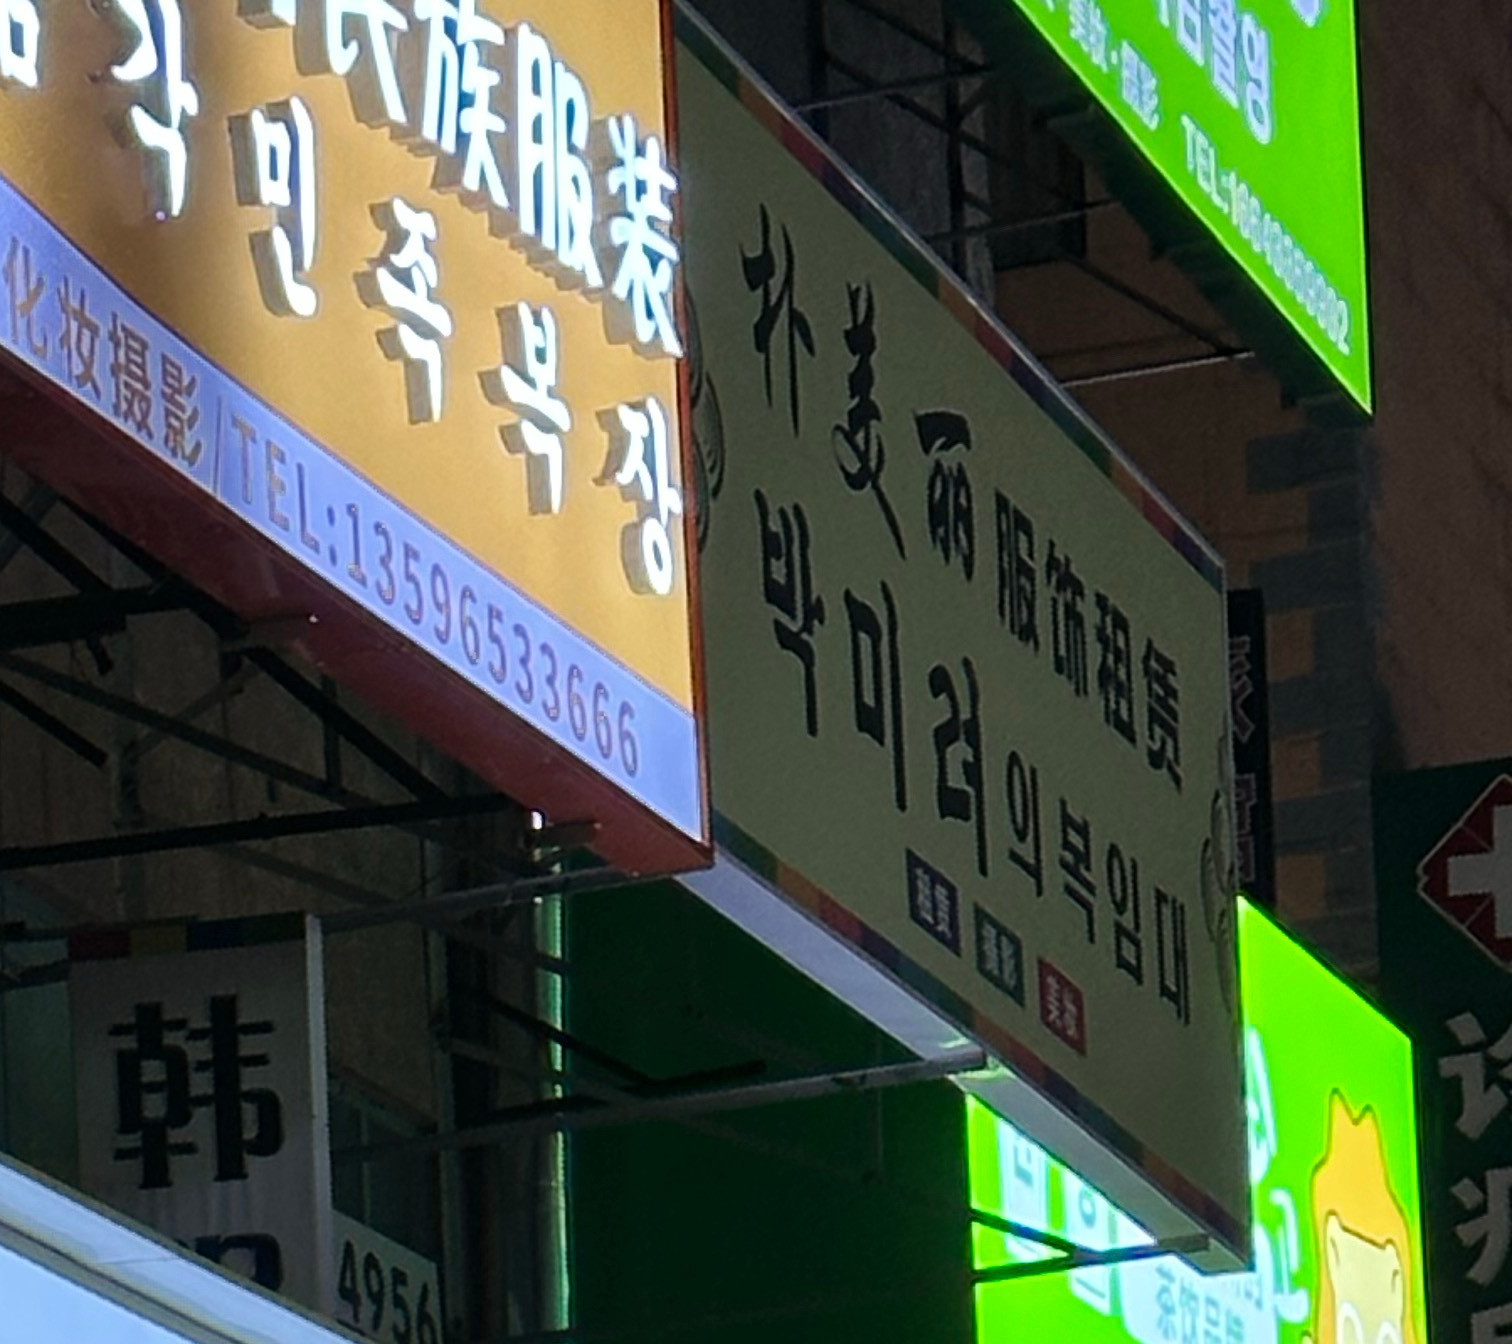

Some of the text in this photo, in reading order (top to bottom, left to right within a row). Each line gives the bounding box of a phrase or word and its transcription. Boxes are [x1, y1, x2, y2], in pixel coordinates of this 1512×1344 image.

[273, 0, 683, 356] 民族服装
[2, 236, 202, 468] 化妆摄影
